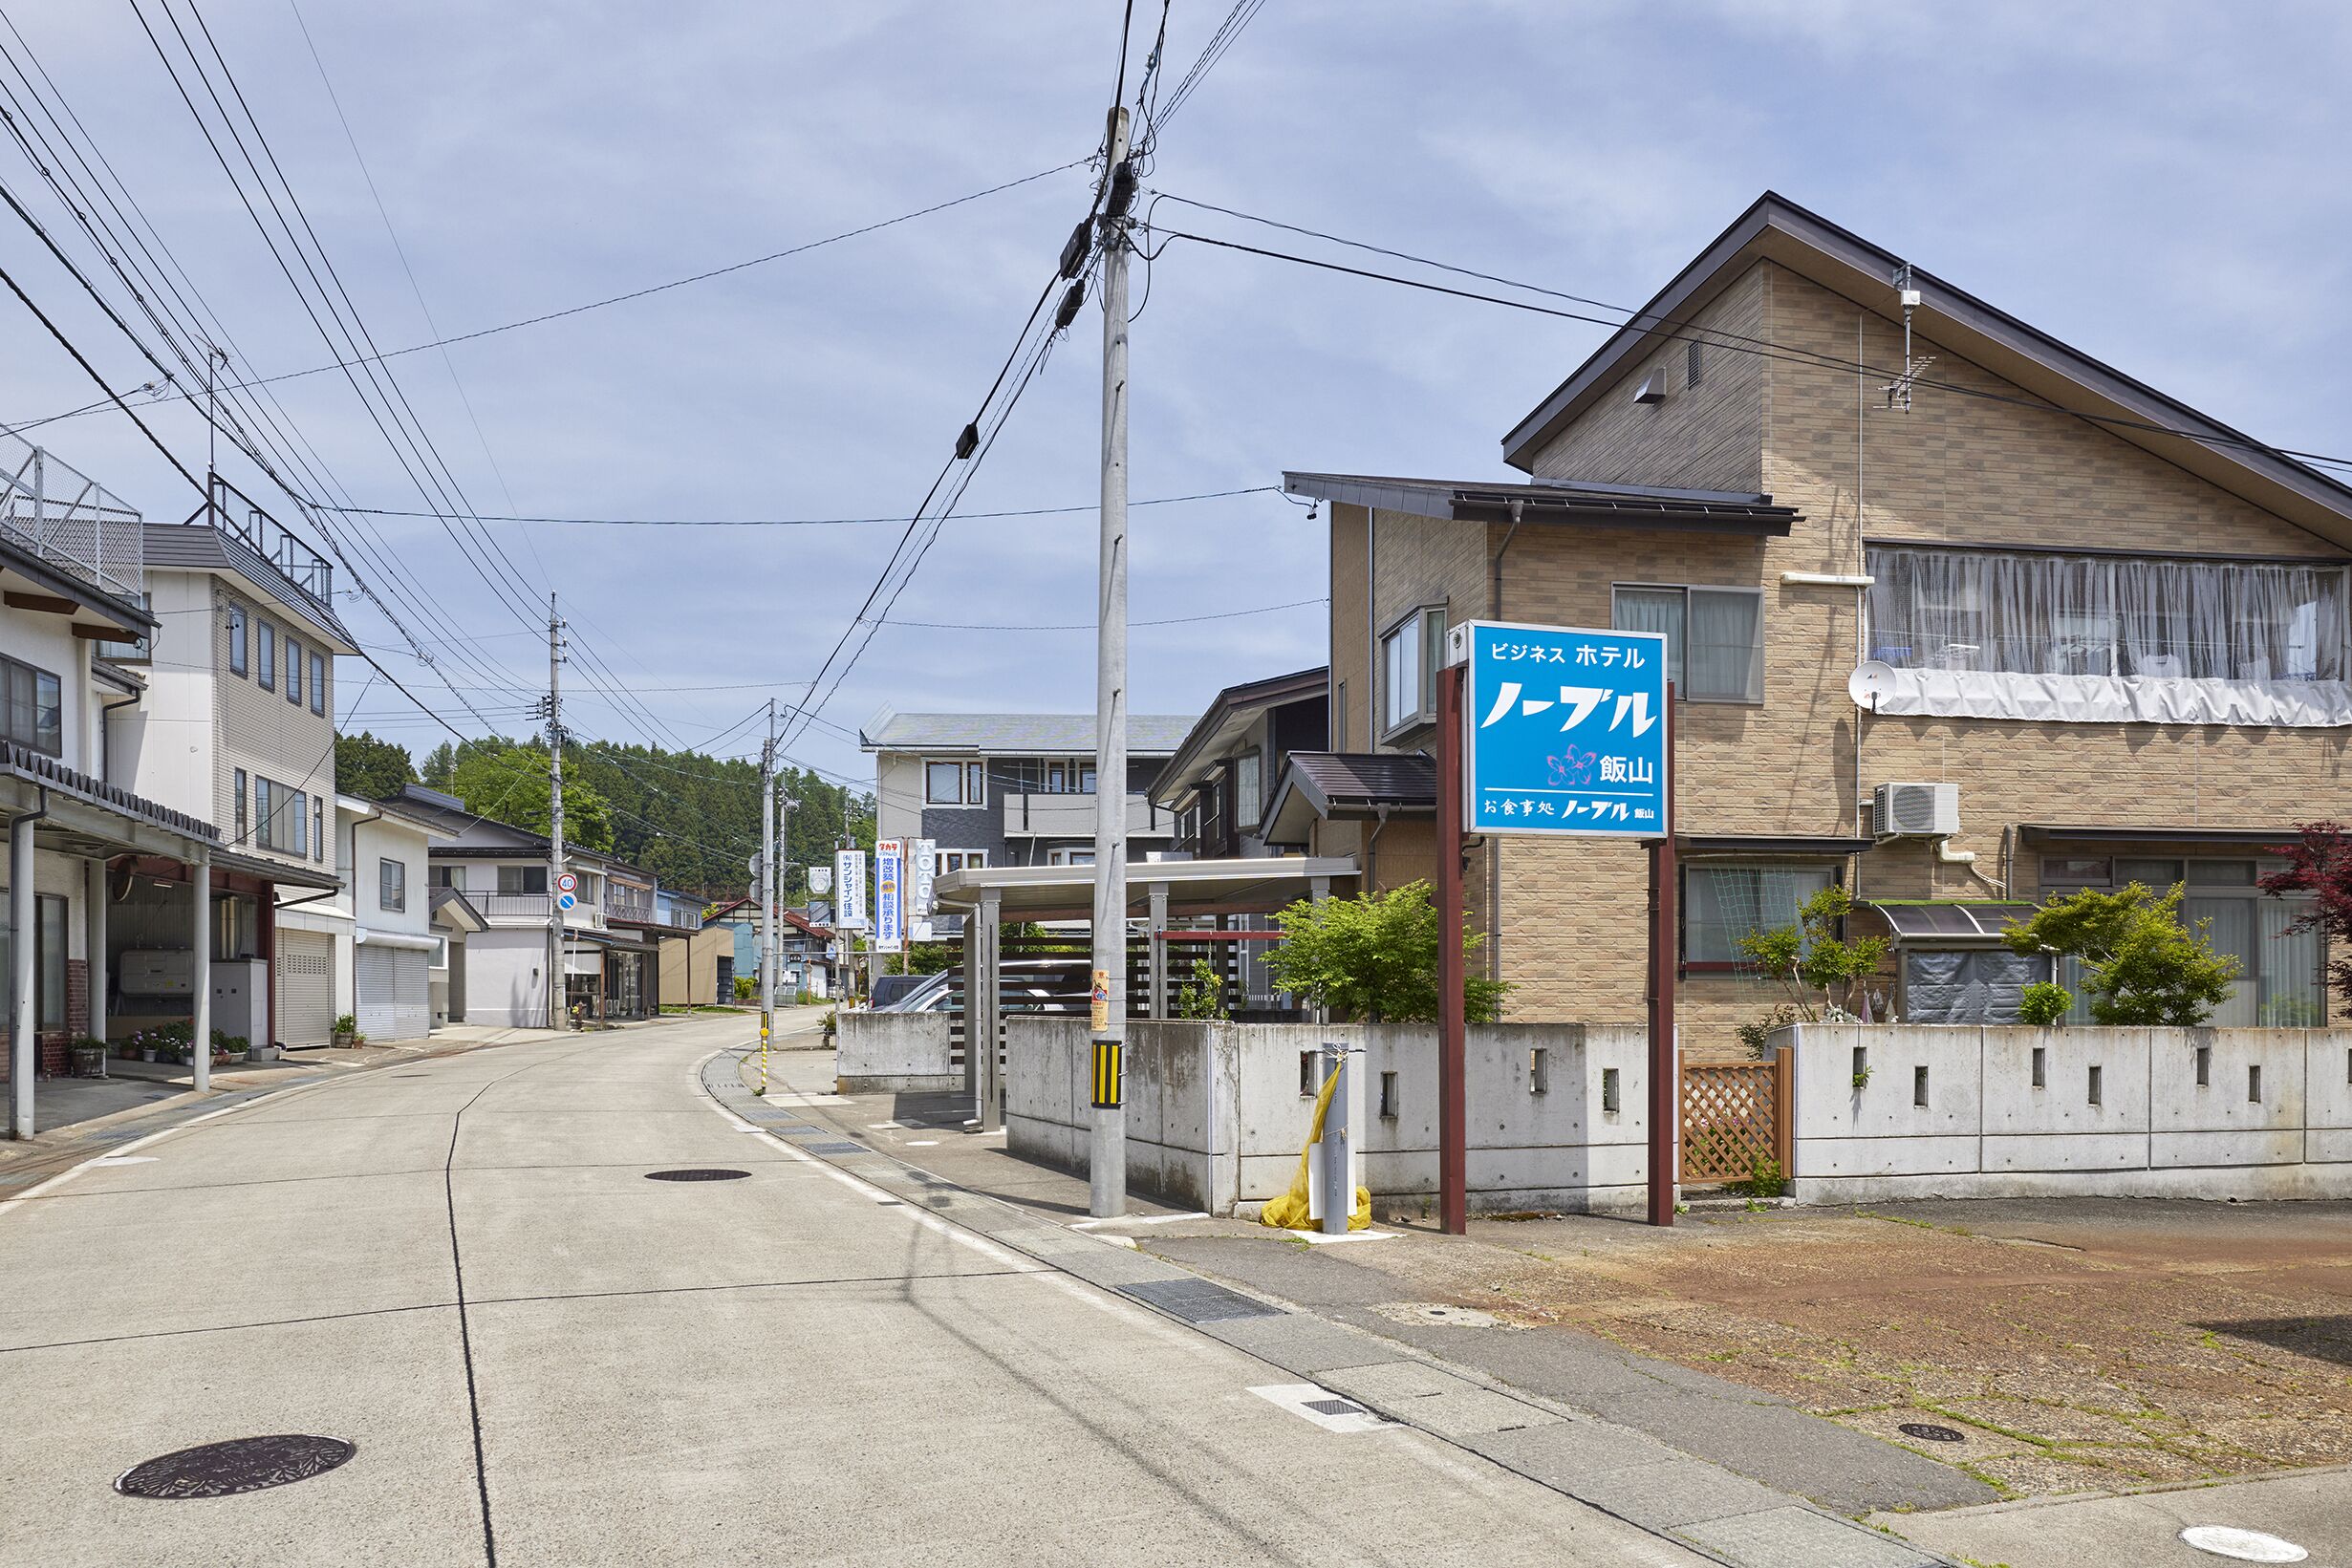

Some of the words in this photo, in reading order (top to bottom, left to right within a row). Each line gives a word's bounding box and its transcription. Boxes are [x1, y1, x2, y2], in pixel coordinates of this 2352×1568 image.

[1492, 643, 1565, 664] ビジネス
[1576, 645, 1646, 669] ホテル
[1479, 681, 1657, 739] ノーブル
[1599, 755, 1653, 784] 飯山
[1484, 798, 1555, 817] お食事処
[1562, 800, 1630, 822] ノーブル
[1634, 807, 1654, 819] 飯山
[562, 879, 572, 888] 40
